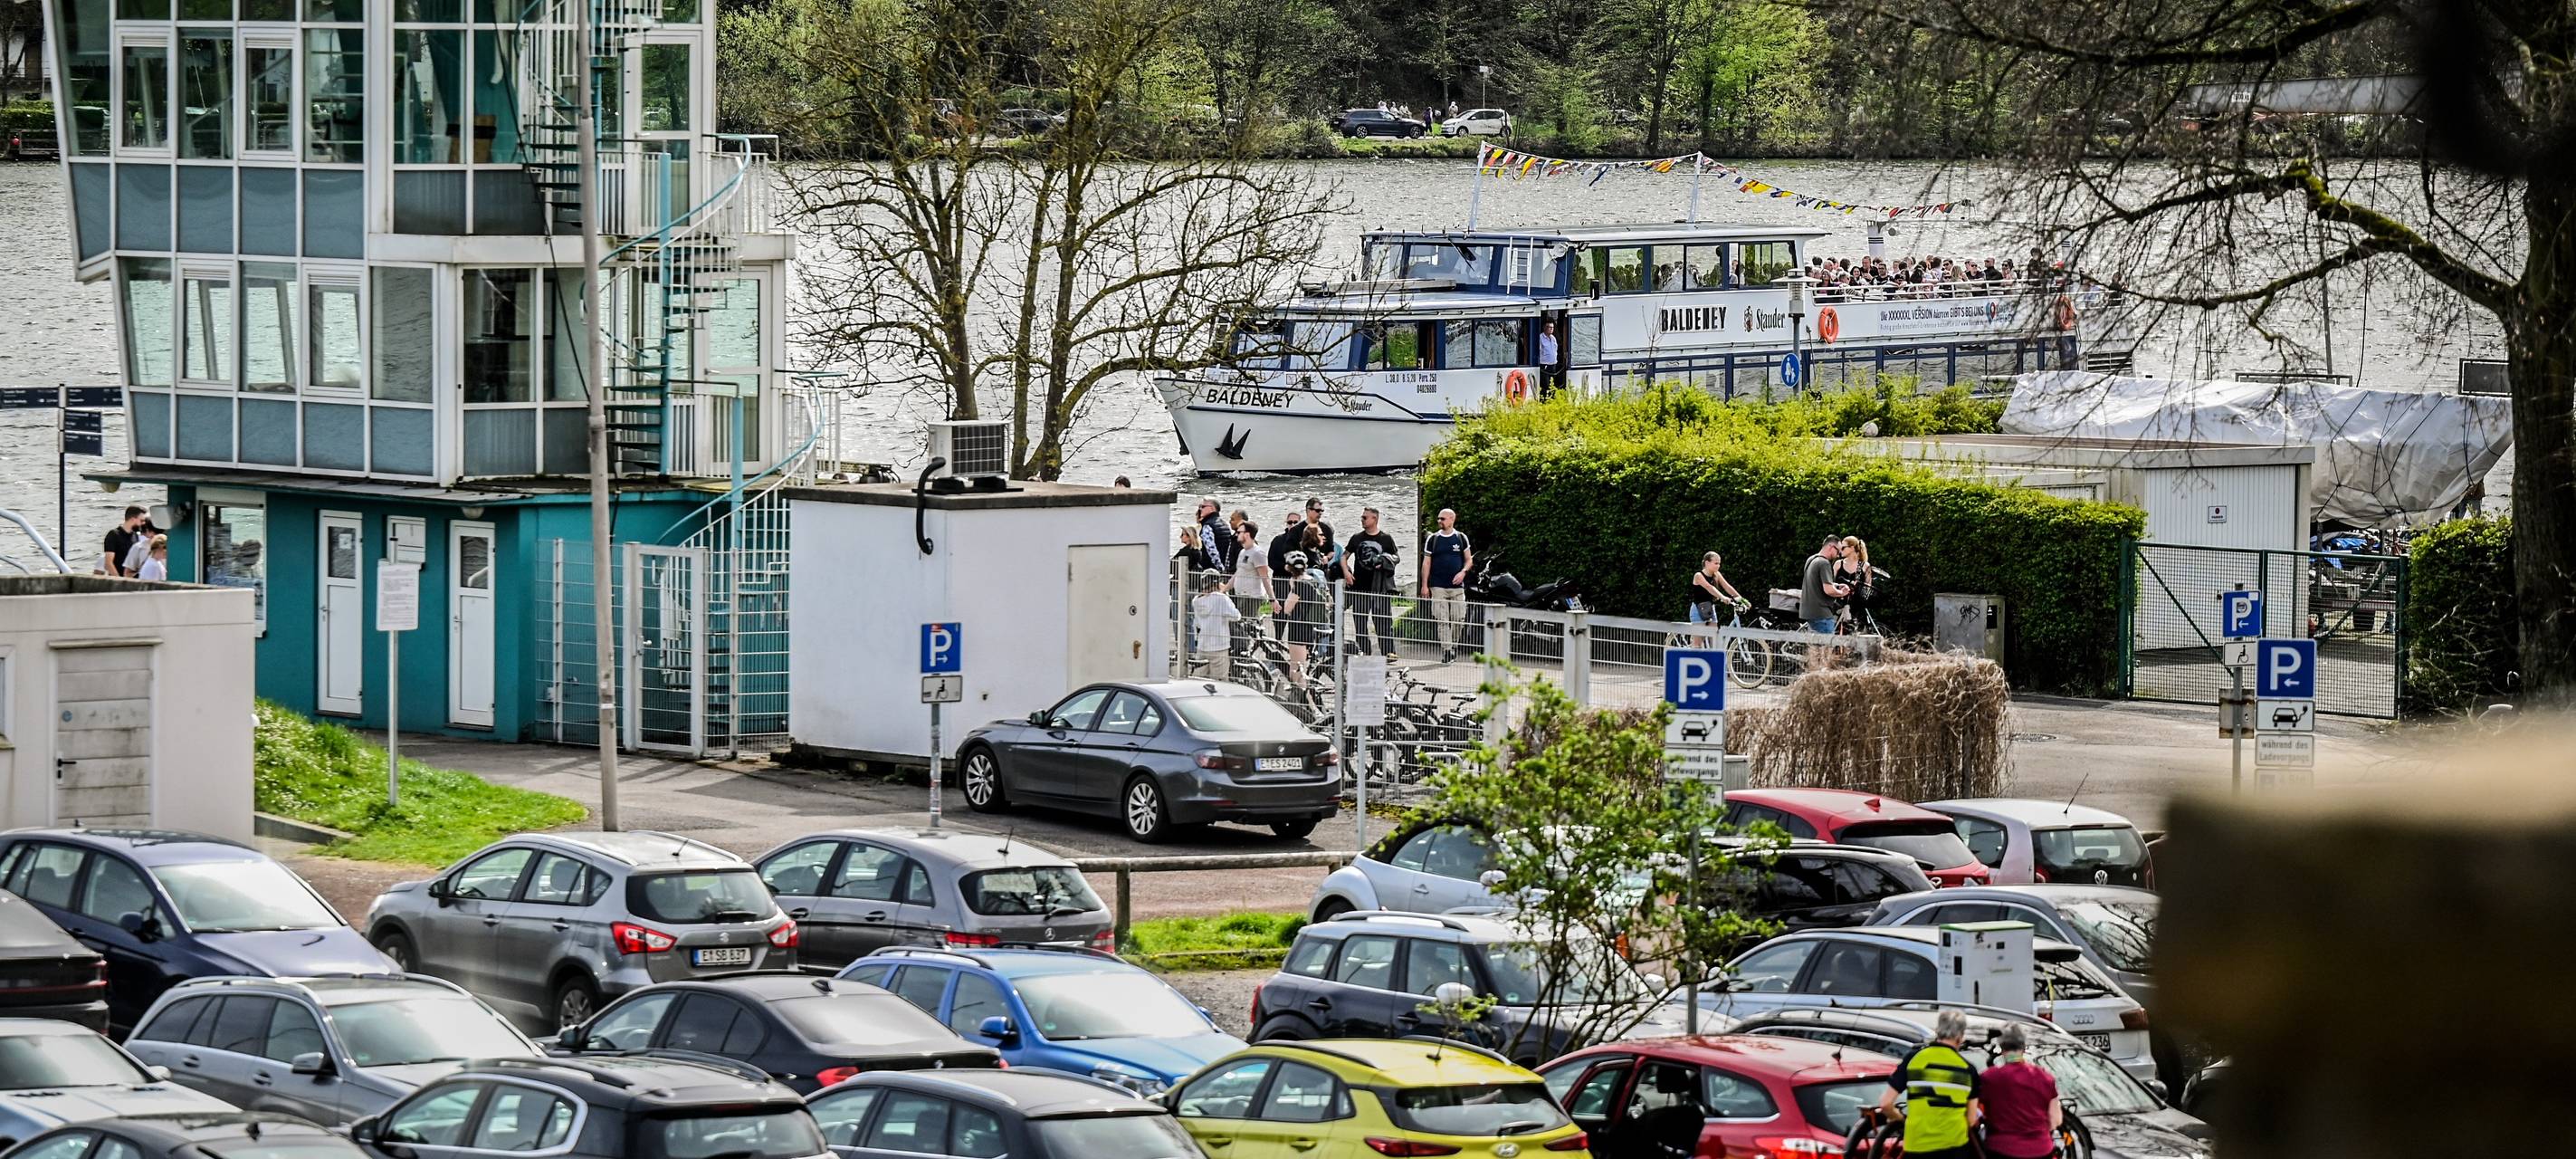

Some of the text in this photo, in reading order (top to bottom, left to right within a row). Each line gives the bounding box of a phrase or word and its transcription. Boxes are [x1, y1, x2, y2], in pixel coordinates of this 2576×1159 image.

[1661, 306, 1727, 331] BALDENEY
[1756, 307, 1786, 331] Stauder
[1912, 309, 1932, 319] VERSION
[1206, 388, 1295, 408] BALDENEY
[2231, 598, 2252, 631] P
[930, 628, 952, 667] P
[1678, 657, 1712, 703] P
[2269, 647, 2302, 690] P
[2261, 739, 2308, 749] während des
[1704, 755, 1717, 763] des
[2091, 1035, 2109, 1048] 236
